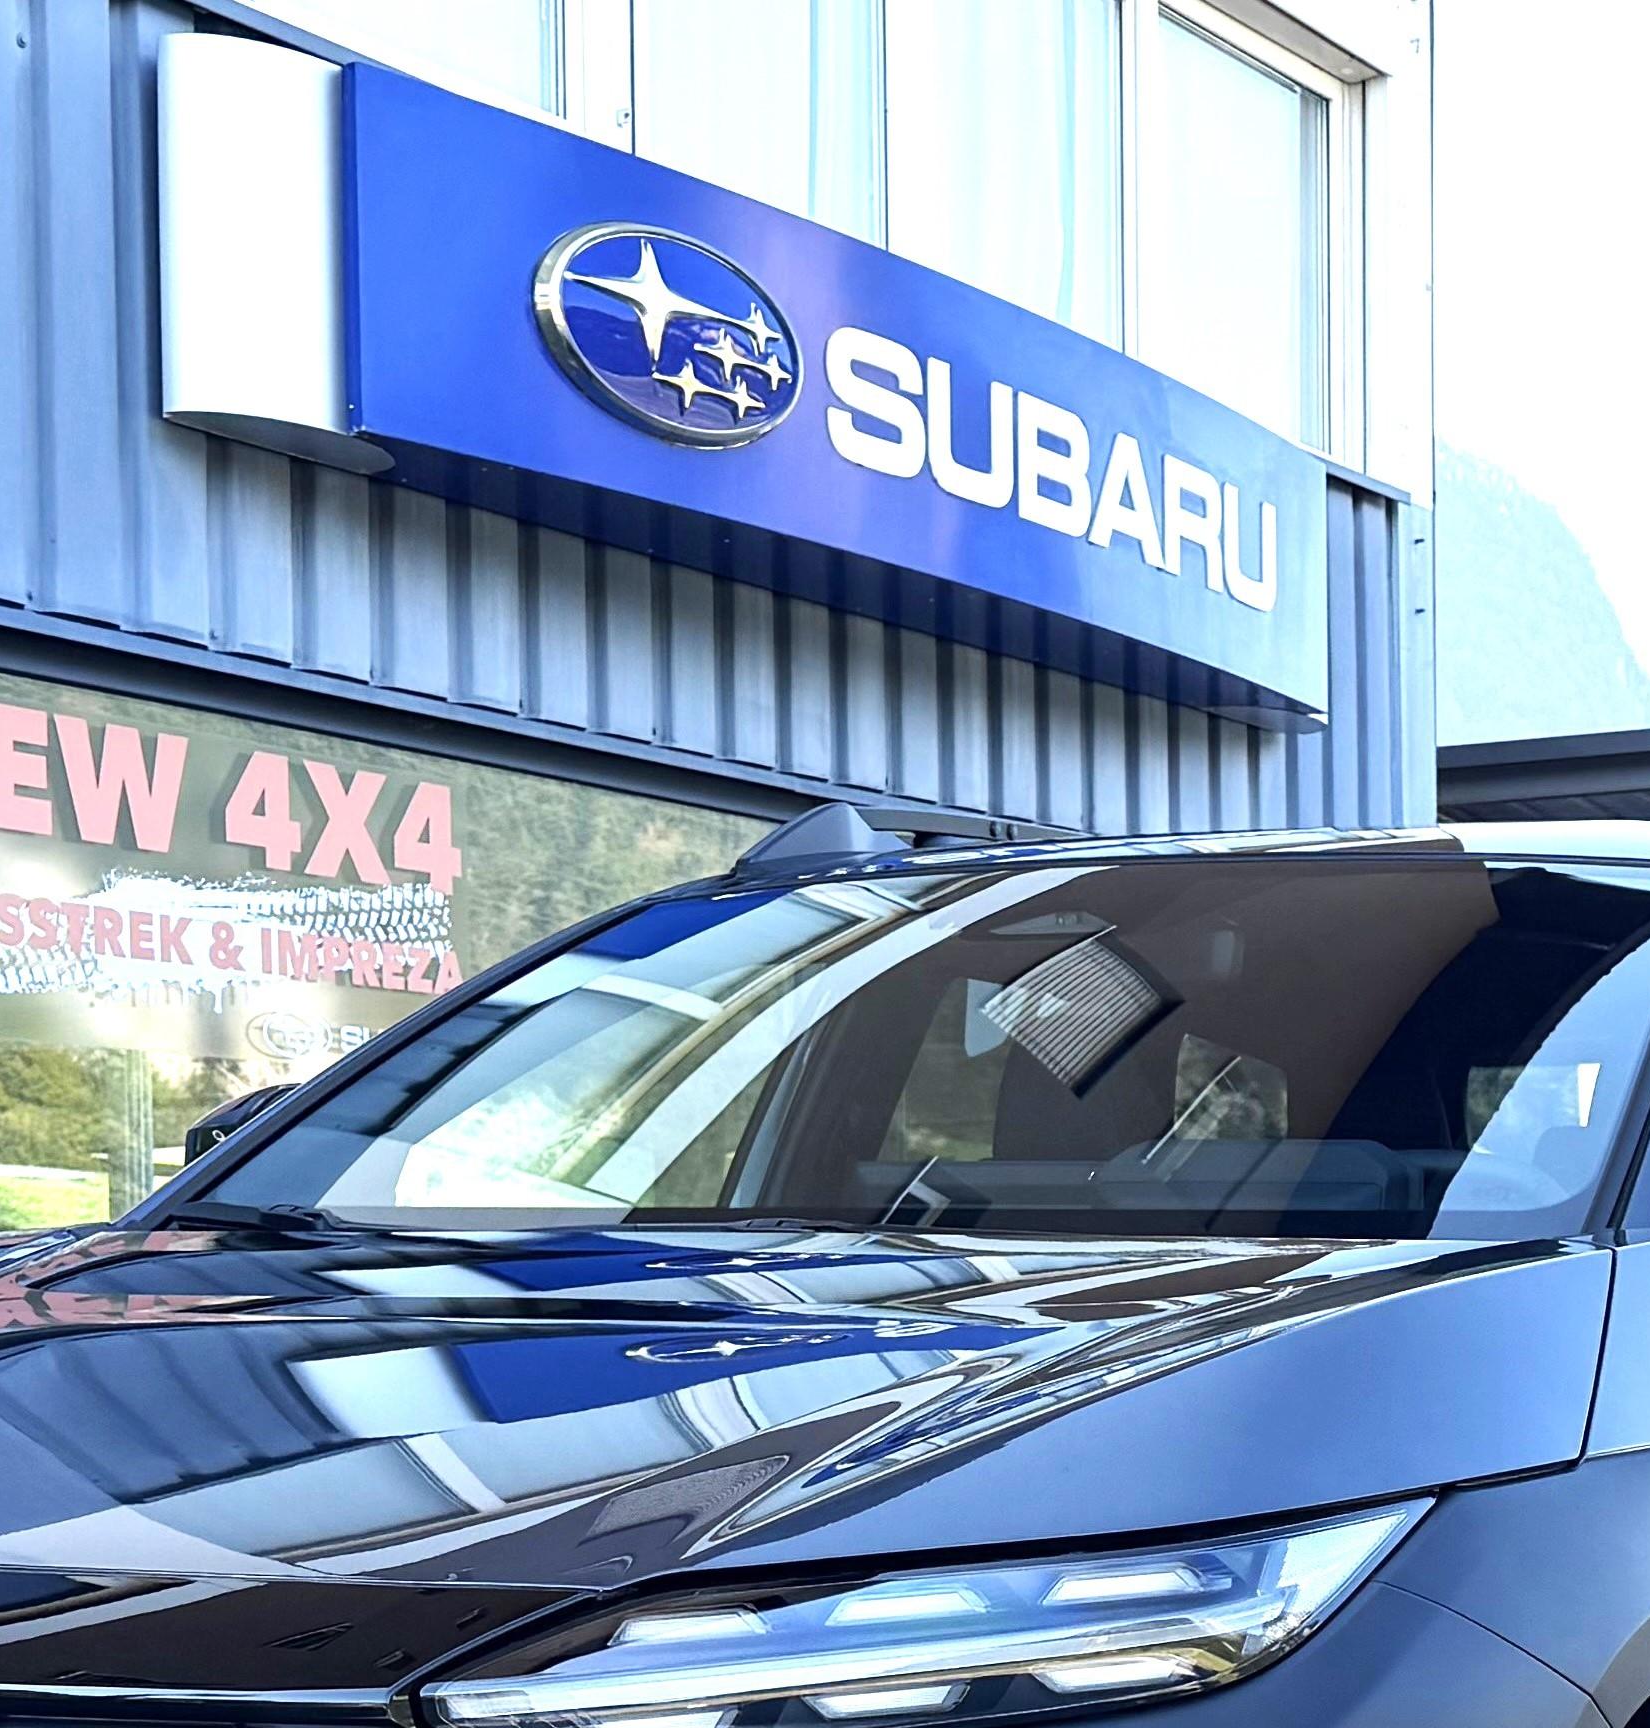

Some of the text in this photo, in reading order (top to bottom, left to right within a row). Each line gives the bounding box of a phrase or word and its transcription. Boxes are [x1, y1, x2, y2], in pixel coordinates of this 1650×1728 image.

[824, 325, 1278, 613] SUBARU
[225, 751, 462, 895] 4X4
[208, 921, 243, 972] &
[260, 928, 463, 996] IMPREZA
